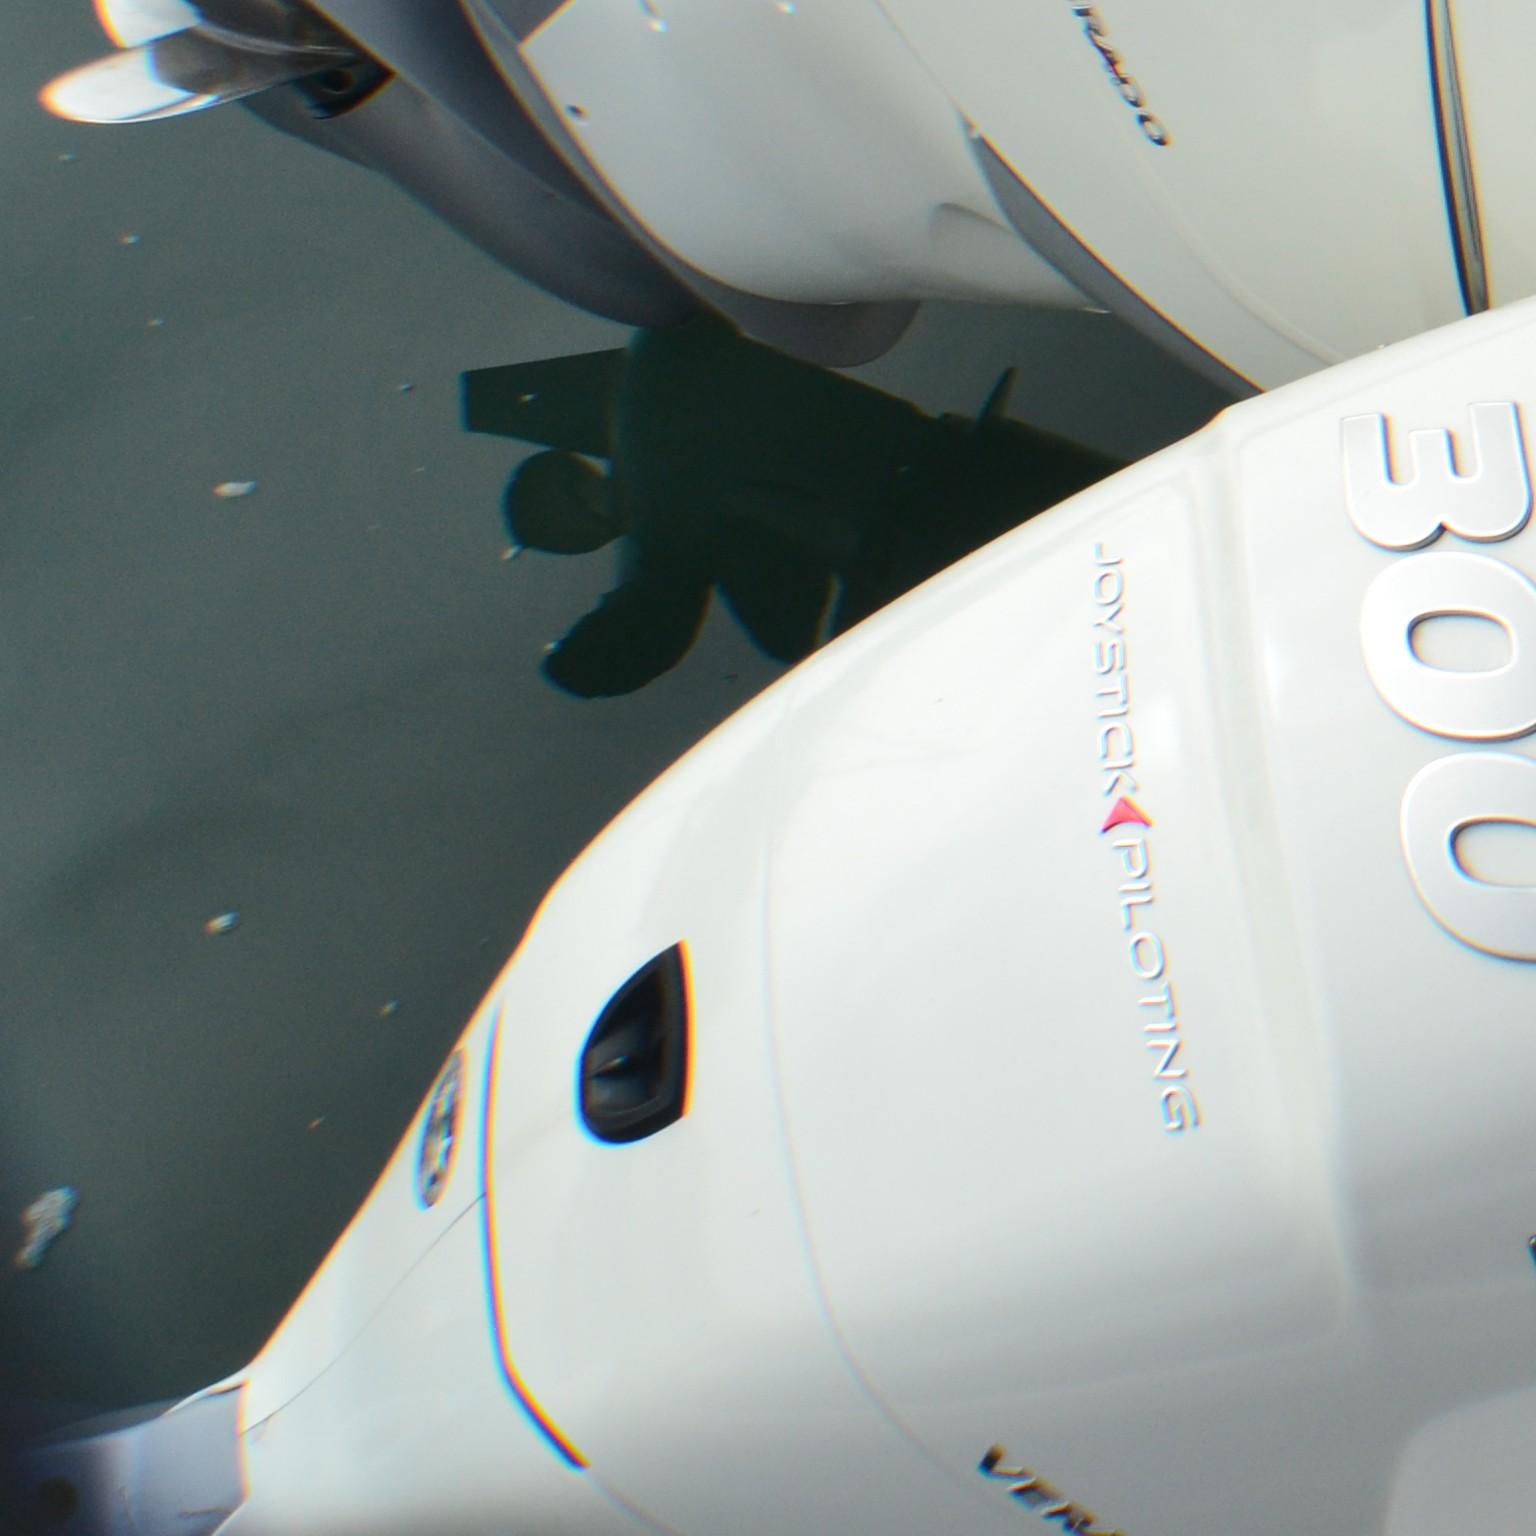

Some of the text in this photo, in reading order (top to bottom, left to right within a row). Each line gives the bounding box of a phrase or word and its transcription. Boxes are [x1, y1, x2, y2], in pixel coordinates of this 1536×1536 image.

[1092, 541, 1200, 1133] JOYSTICK PILOTING
[976, 1442, 1127, 1536] VER
